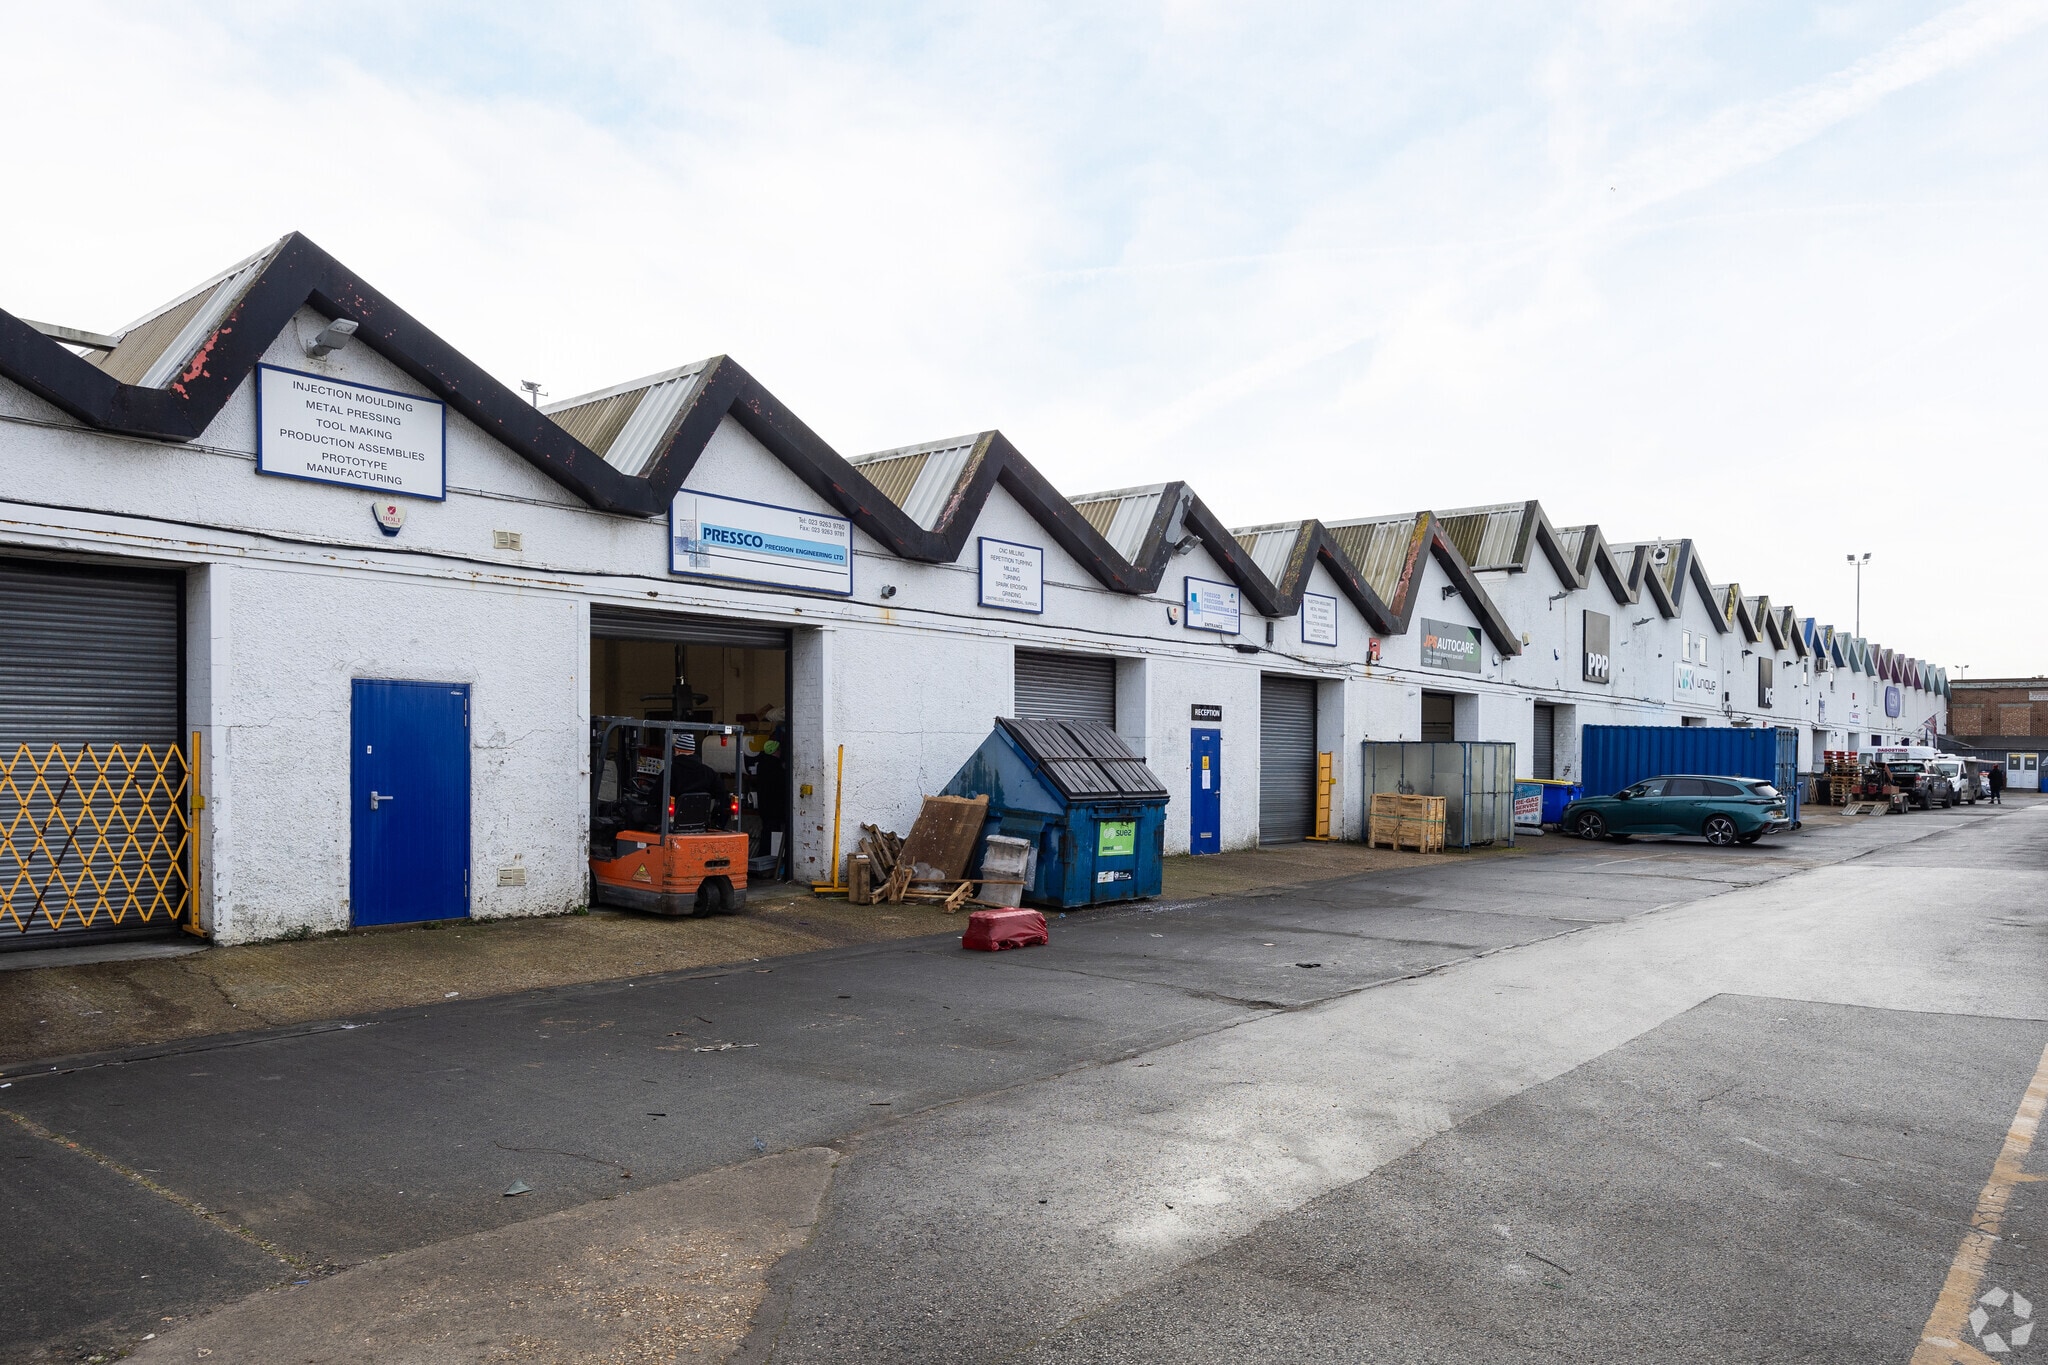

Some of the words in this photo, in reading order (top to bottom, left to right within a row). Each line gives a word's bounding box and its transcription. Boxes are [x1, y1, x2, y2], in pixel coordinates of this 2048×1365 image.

[292, 381, 352, 400] INJECTION
[355, 393, 412, 412] MOULDING
[306, 400, 344, 414] METAL
[347, 408, 401, 426] PRESSING
[316, 418, 346, 432] TOOL
[350, 424, 392, 440] MAKING
[280, 428, 354, 449] PRODUCTION
[358, 442, 425, 461] ASSEMBLIES
[322, 452, 388, 470] PROTOTYPE
[306, 462, 402, 485] MANUFACTURING
[703, 527, 763, 548] PRESSCO
[765, 543, 794, 553] PRECISION
[796, 548, 832, 559] ENGINEERING
[1009, 549, 1025, 557] MILLING
[990, 554, 1014, 564] REPETITION
[1015, 558, 1032, 567] TURNING
[1588, 652, 1609, 677] PPP
[1195, 709, 1220, 717] RECEPTION
[1516, 797, 1539, 805] RE-GAS
